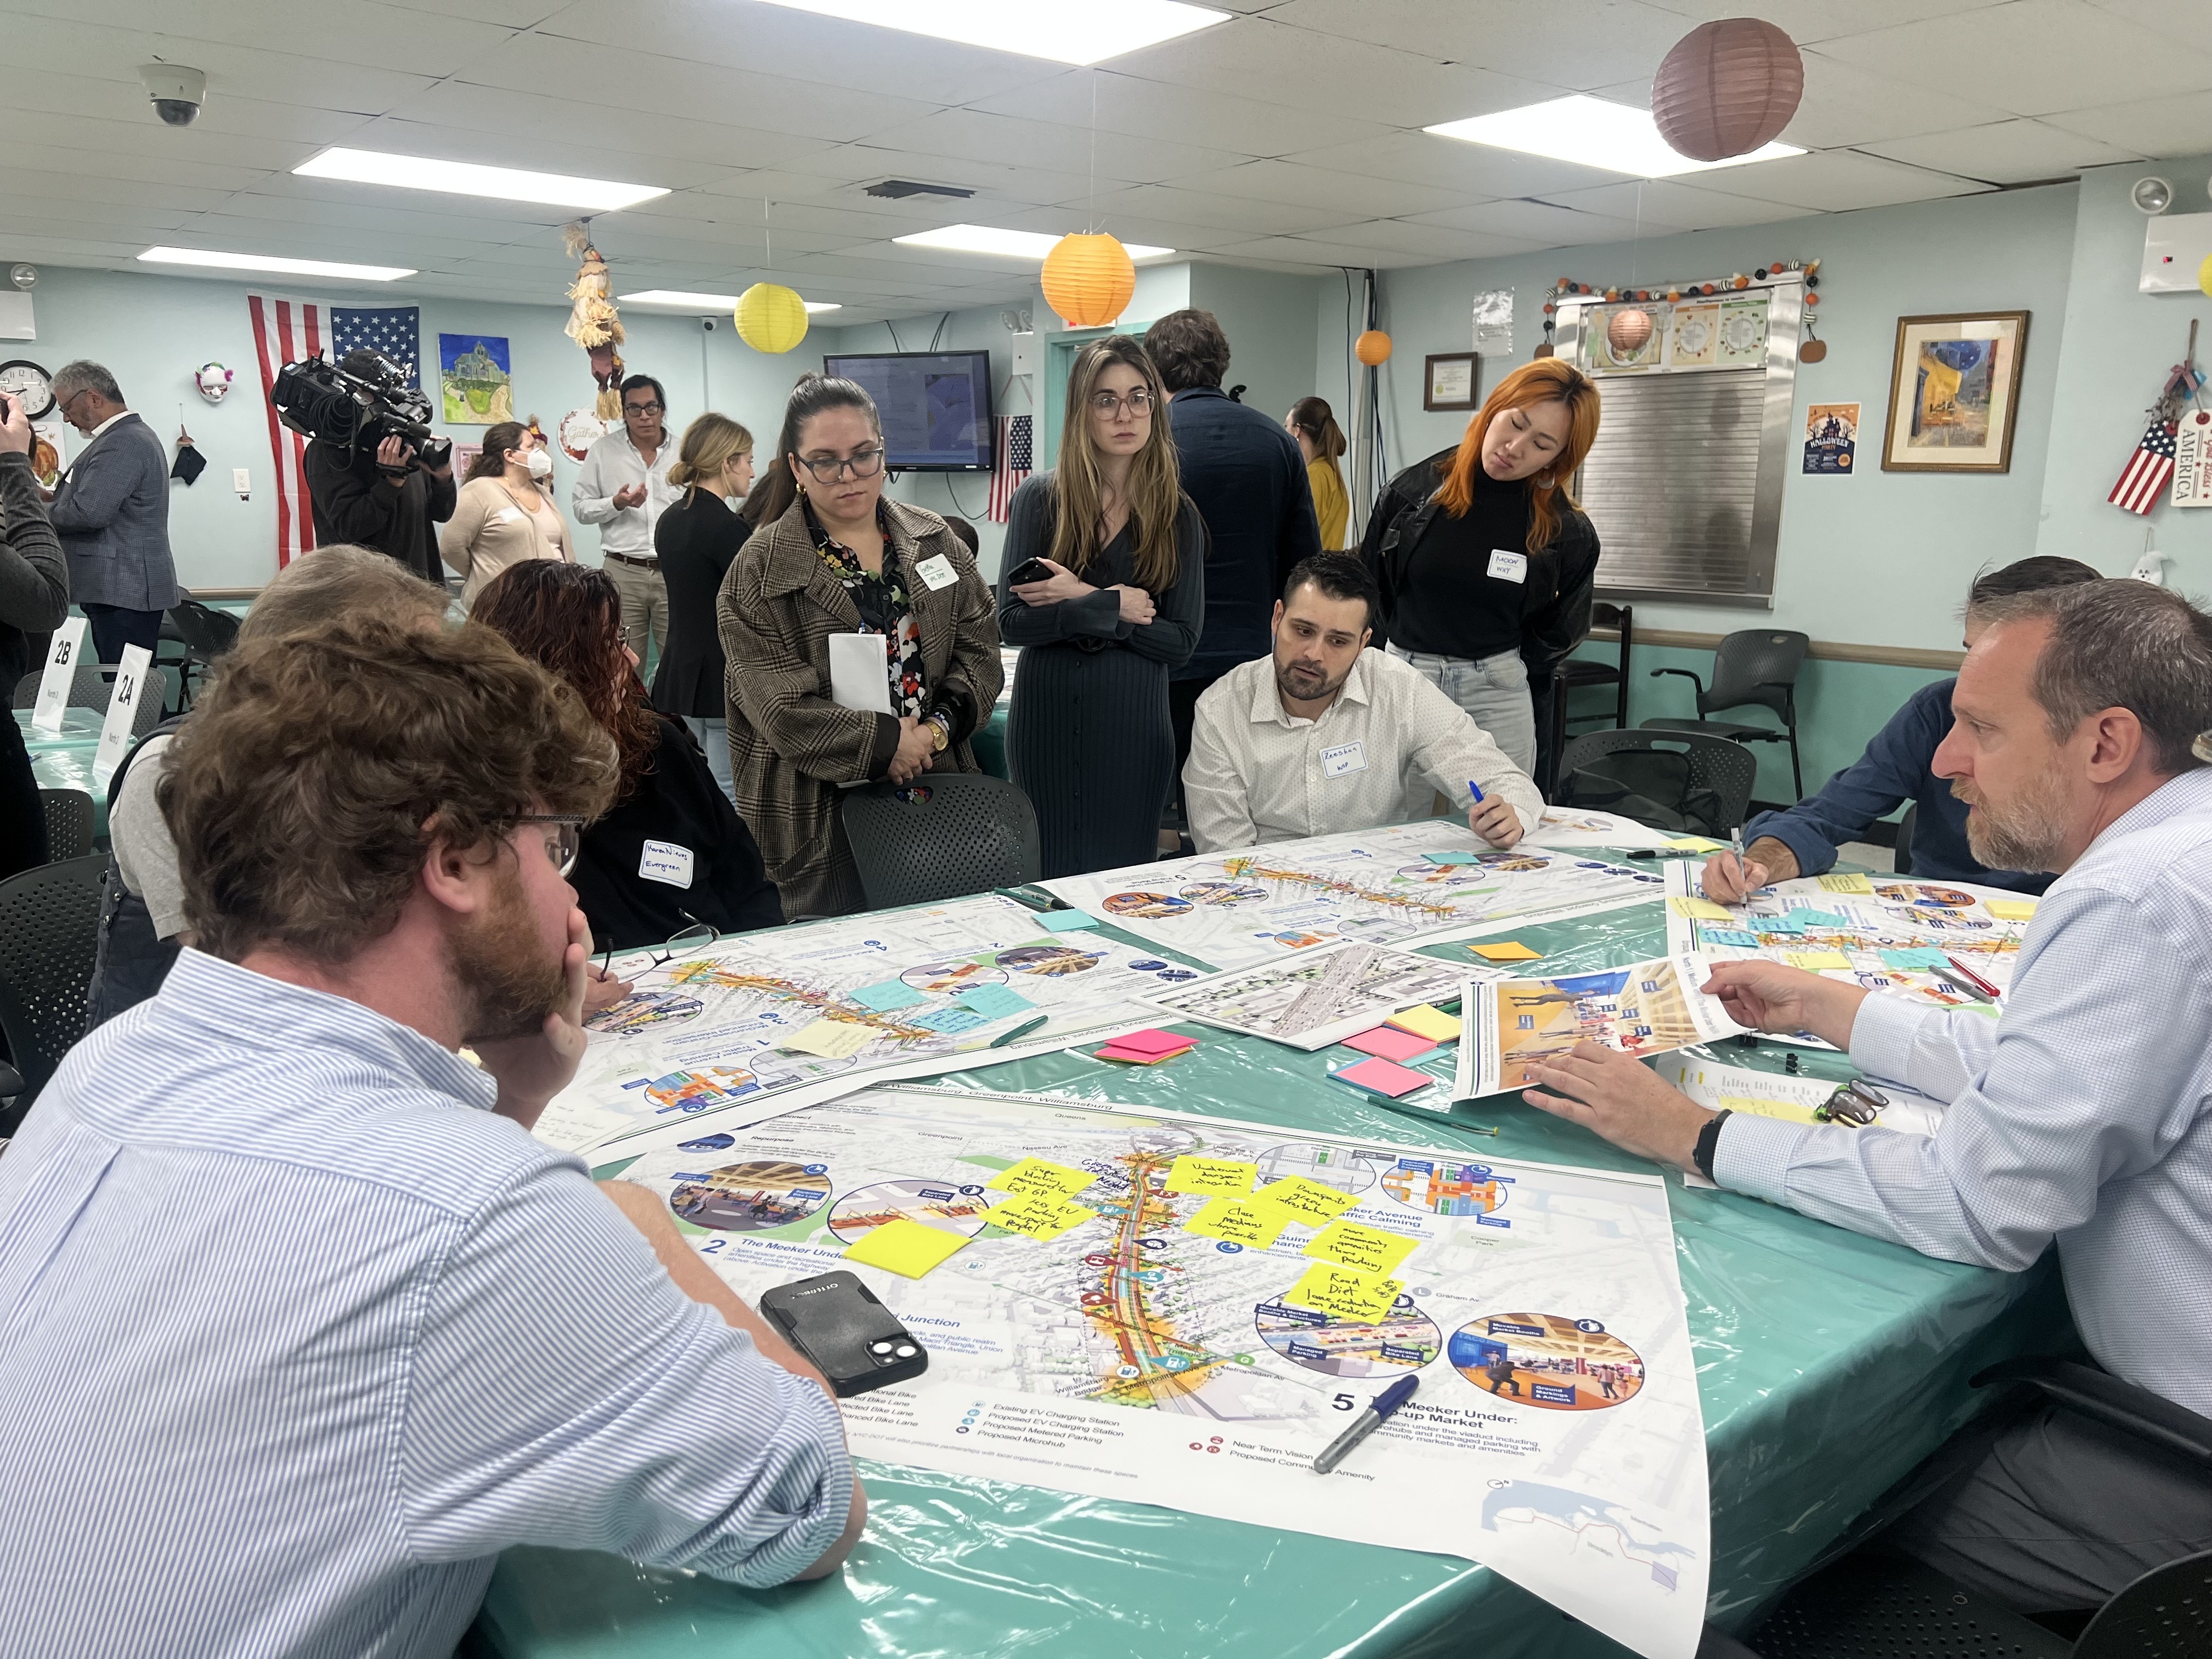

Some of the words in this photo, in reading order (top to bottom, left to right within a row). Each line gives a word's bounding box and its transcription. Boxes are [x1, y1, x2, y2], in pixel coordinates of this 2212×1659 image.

[1810, 437, 1849, 448] HALLOWEEN
[2176, 429, 2196, 500] AMERICA
[1496, 555, 1519, 565] MOON
[55, 640, 71, 664] 2B
[118, 674, 134, 706] 2A
[1324, 747, 1357, 760] Zeeshan
[646, 861, 680, 872] Evergreen
[1009, 1036, 1069, 1050] Williamsburg
[891, 1084, 964, 1096] Williamsburg,
[969, 1091, 1034, 1102] Greenpoint,
[1039, 1097, 1113, 1110] Williamsburg
[917, 1131, 963, 1141] Greenpoint
[1007, 1183, 1027, 1193] East
[1369, 1215, 1421, 1228] Calming
[1375, 1210, 1423, 1221] Avenue
[1405, 1228, 1435, 1236] calming
[701, 1239, 727, 1254] 2
[742, 1238, 764, 1247] The
[767, 1242, 811, 1255] Meeker
[727, 1251, 760, 1261] amenities
[761, 1256, 786, 1265] under
[799, 1261, 830, 1272] highway
[732, 1246, 752, 1255] Open
[754, 1250, 775, 1259] space
[792, 1256, 836, 1266] recreational
[752, 1260, 787, 1270] Activation
[788, 1265, 809, 1273] under
[1330, 1272, 1361, 1287] Road
[1328, 1283, 1358, 1296] Diet
[1435, 1292, 1468, 1302] Graham
[1260, 1305, 1285, 1313] Movable
[1287, 1309, 1308, 1317] Market
[901, 1314, 961, 1328] Junction
[1288, 1314, 1322, 1323] Structures
[918, 1335, 943, 1344] Macri
[944, 1339, 976, 1350] Triangle,
[978, 1344, 1004, 1353] Union
[947, 1334, 971, 1343] public
[972, 1338, 997, 1346] realm
[1457, 1332, 1484, 1344] TACO
[946, 1345, 979, 1355] Avenue
[1168, 1348, 1202, 1358] Triangle
[1291, 1349, 1317, 1358] Parking
[1293, 1345, 1323, 1355] Managed
[1385, 1346, 1420, 1356] Separated
[1125, 1370, 1180, 1391] Metropolitan
[1181, 1365, 1200, 1378] Ave
[1221, 1365, 1277, 1379] Metropolitan
[1055, 1376, 1109, 1394] Williamsburg
[1074, 1386, 1102, 1397] Bridge
[1536, 1385, 1563, 1393] Ground
[1536, 1390, 1569, 1399] Markings
[1542, 1395, 1571, 1403] Artwork
[888, 1399, 910, 1407] Lane
[1331, 1393, 1355, 1411] 5
[891, 1409, 915, 1417] Lane
[994, 1403, 1028, 1414] Existing
[1046, 1410, 1086, 1423] Charging
[1088, 1416, 1120, 1427] Station
[1402, 1401, 1461, 1417] Meeker
[1464, 1409, 1518, 1425] Under:
[895, 1418, 919, 1427] Lane
[988, 1412, 1031, 1424] Proposed
[1049, 1420, 1090, 1432] Charging
[1092, 1426, 1125, 1438] Station
[1429, 1413, 1485, 1429] Market
[977, 1429, 1022, 1442] Proposed
[1023, 1435, 1065, 1448] Microhub
[983, 1420, 1026, 1432] Proposed
[1028, 1426, 1066, 1438] Metered
[1068, 1432, 1103, 1444] Parking
[1412, 1423, 1440, 1433] under
[1459, 1430, 1494, 1441] viaduct
[1496, 1436, 1538, 1448] including
[1414, 1429, 1434, 1437] and
[1435, 1432, 1481, 1445] managed
[1483, 1440, 1519, 1451] parking
[1521, 1445, 1541, 1453] with
[1416, 1436, 1455, 1447] markets
[1457, 1442, 1476, 1450] and
[1477, 1446, 1525, 1457] amenities
[911, 1440, 940, 1448] prioritize
[939, 1444, 980, 1455] partnerships
[996, 1452, 1013, 1460] local
[1013, 1454, 1054, 1466] organization
[1232, 1440, 1257, 1450] Near
[1259, 1444, 1283, 1455] Term
[1284, 1449, 1314, 1460] Vision
[1229, 1449, 1276, 1464] Proposed
[1334, 1468, 1376, 1482] Amenity
[1587, 1541, 1614, 1558] Brooklyn
